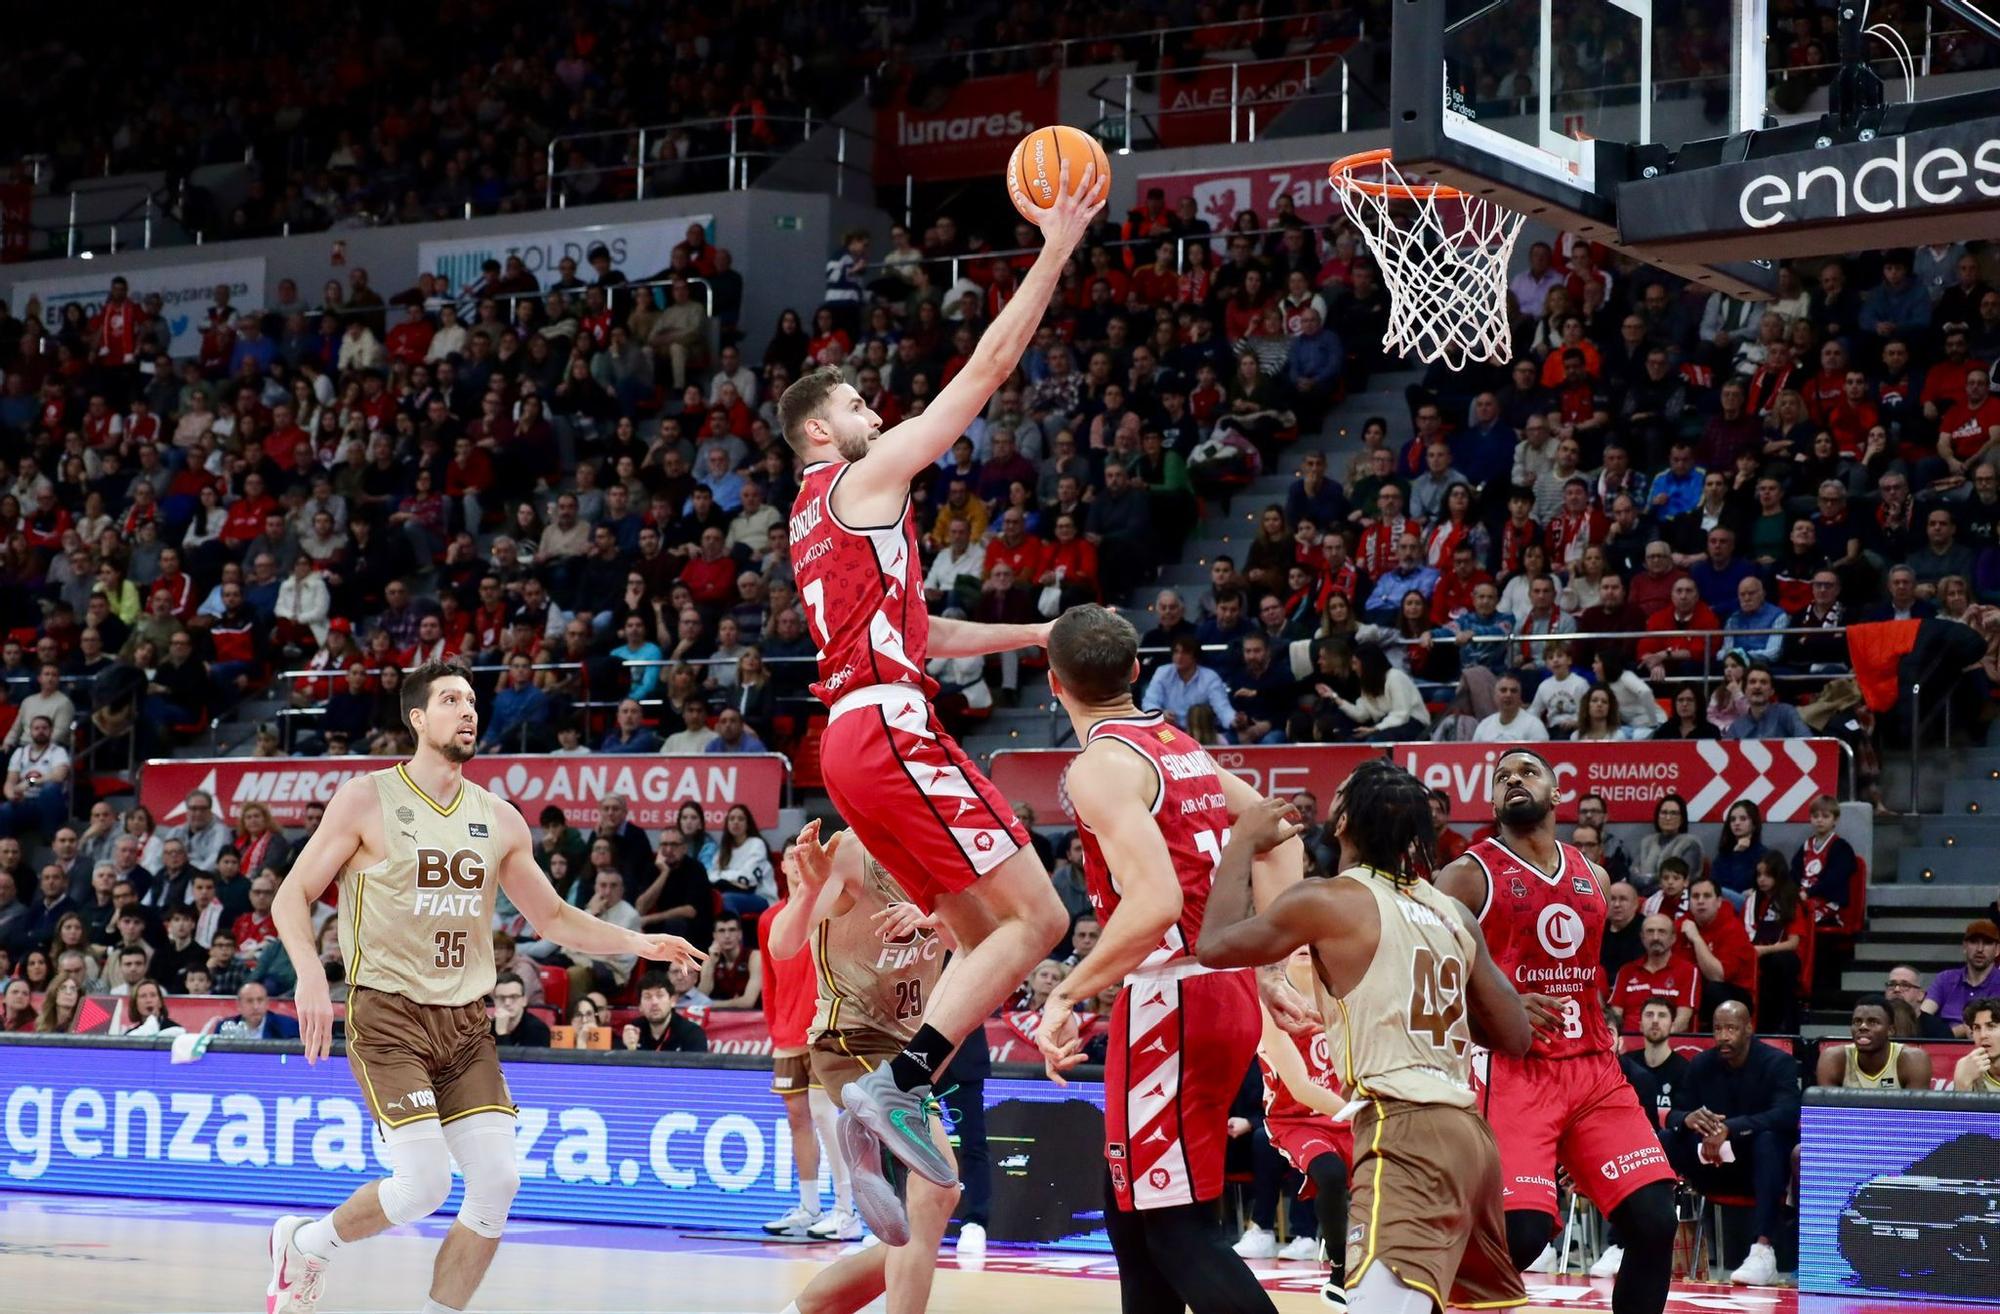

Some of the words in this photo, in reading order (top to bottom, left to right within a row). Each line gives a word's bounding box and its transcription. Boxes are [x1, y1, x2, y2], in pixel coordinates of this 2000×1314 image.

[897, 109, 1035, 147] lunares.
[545, 765, 738, 803] ANAGAN
[1588, 763, 1679, 779] SUMAMOS
[1181, 799, 1197, 815] AIR
[1590, 782, 1677, 801] ENERGÍAS
[639, 809, 661, 824] DE
[416, 848, 487, 890] BG
[434, 929, 468, 970] 35
[895, 977, 922, 1020] 29
[1407, 946, 1466, 1059] 42
